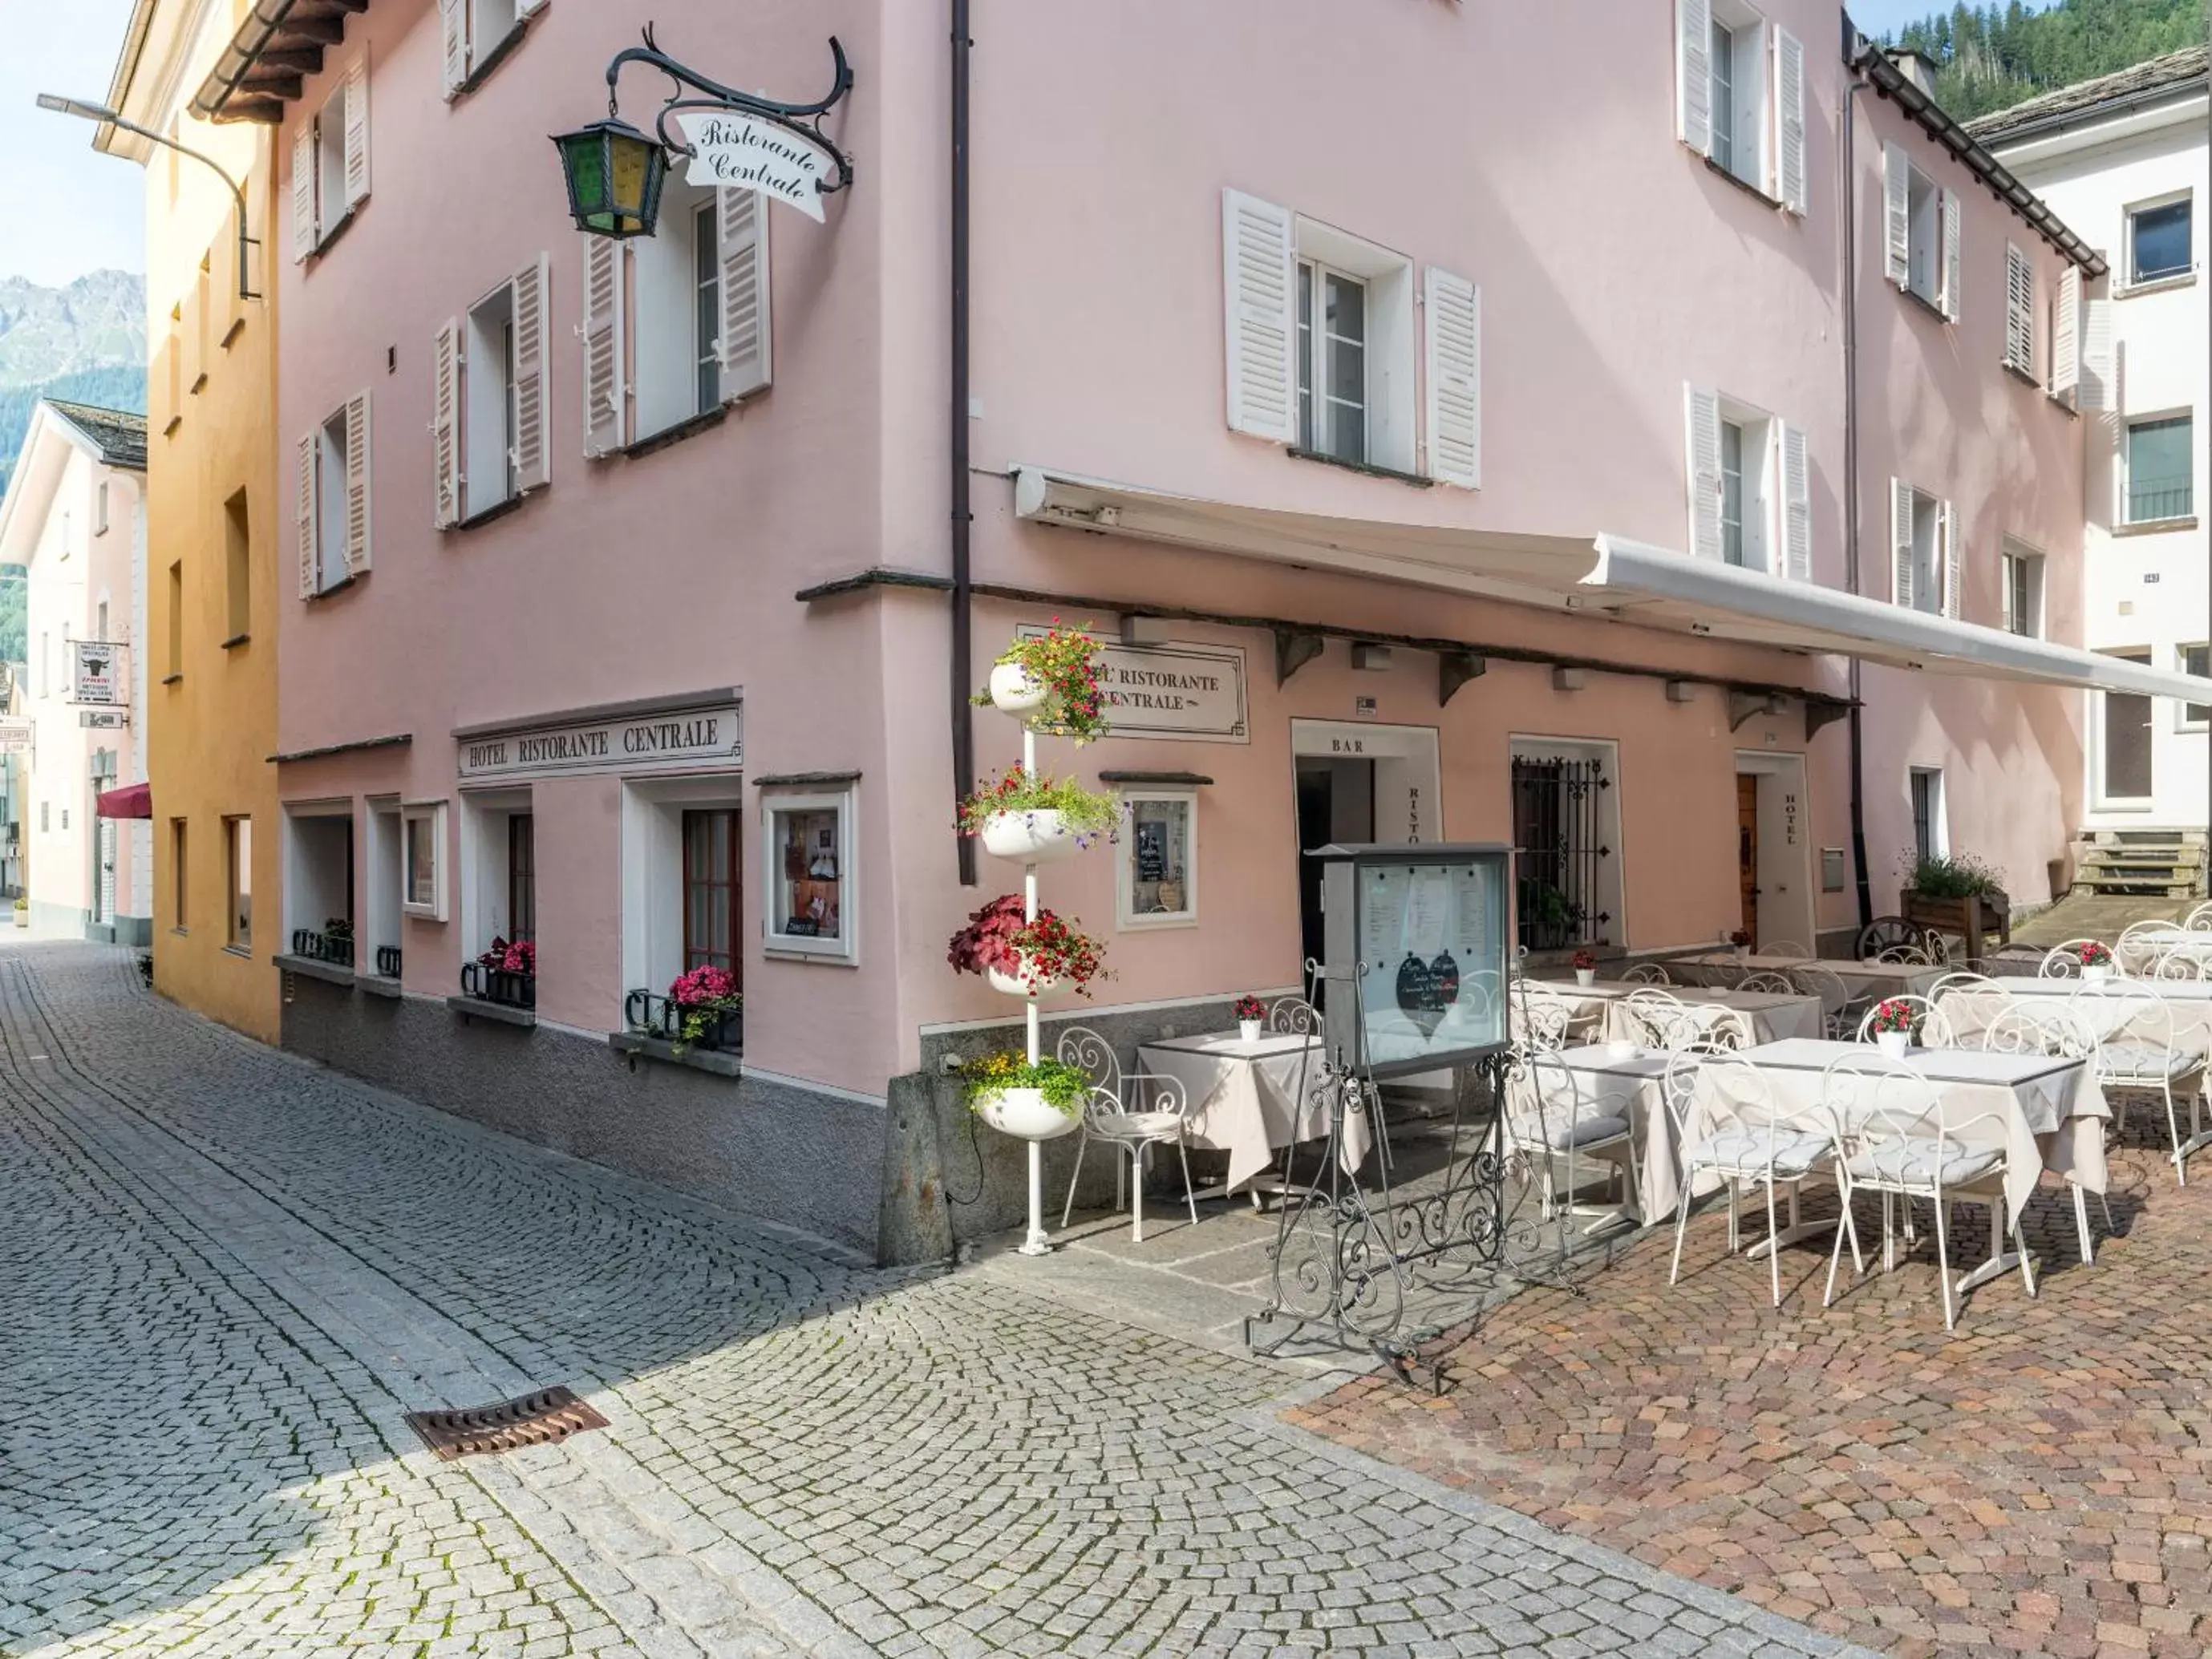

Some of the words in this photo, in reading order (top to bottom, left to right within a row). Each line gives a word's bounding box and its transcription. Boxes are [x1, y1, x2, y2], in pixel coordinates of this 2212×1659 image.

[701, 119, 815, 172] Ristorante
[709, 153, 804, 199] Centrale
[1120, 669, 1219, 691] RISTORANTE
[469, 743, 508, 767] HOTEL
[519, 732, 609, 763] RISTORANTE
[623, 718, 719, 754] CENTRALE
[1332, 739, 1363, 752] BAR
[1785, 795, 1797, 845] HOTEL
